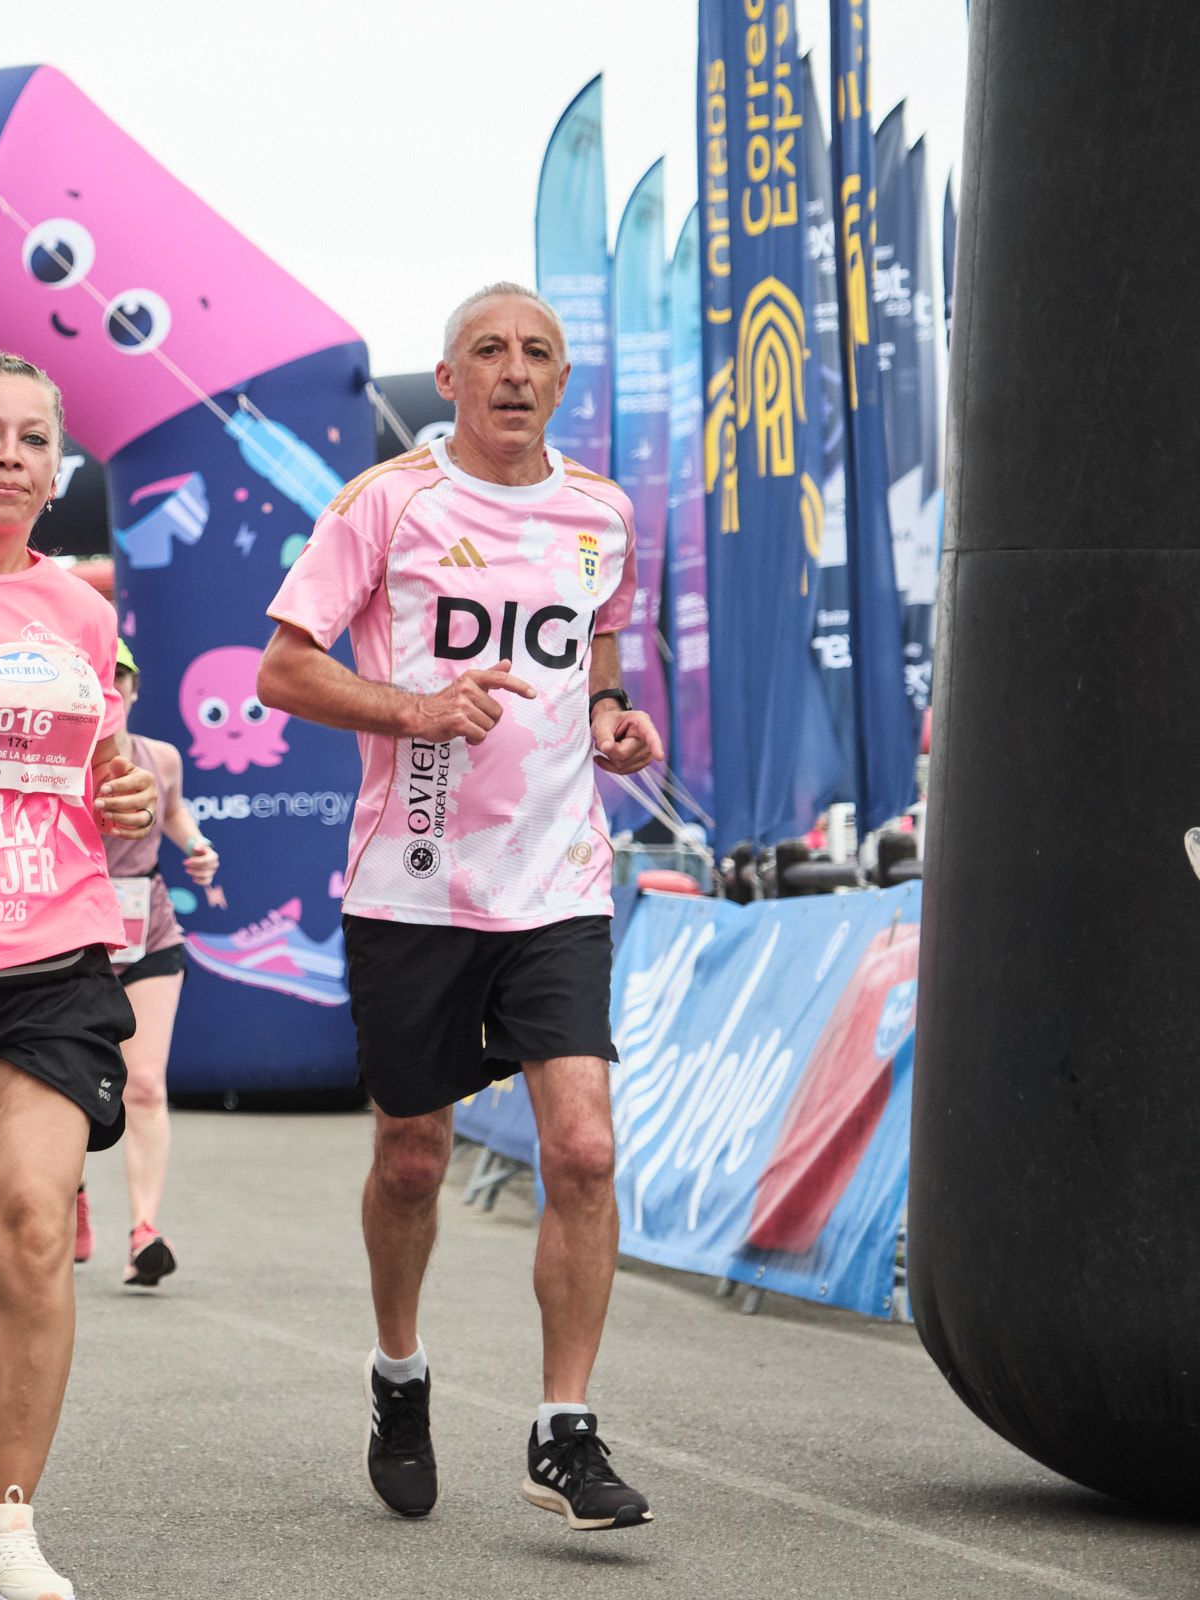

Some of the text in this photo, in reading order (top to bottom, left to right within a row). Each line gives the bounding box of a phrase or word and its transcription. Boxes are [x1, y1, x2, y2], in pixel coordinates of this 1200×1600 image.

[8, 736, 33, 750] 174
[9, 750, 20, 760] LA
[30, 773, 68, 786] Santander
[436, 762, 450, 787] DEL
[251, 790, 356, 826] energy
[433, 789, 447, 838] ORIGEN
